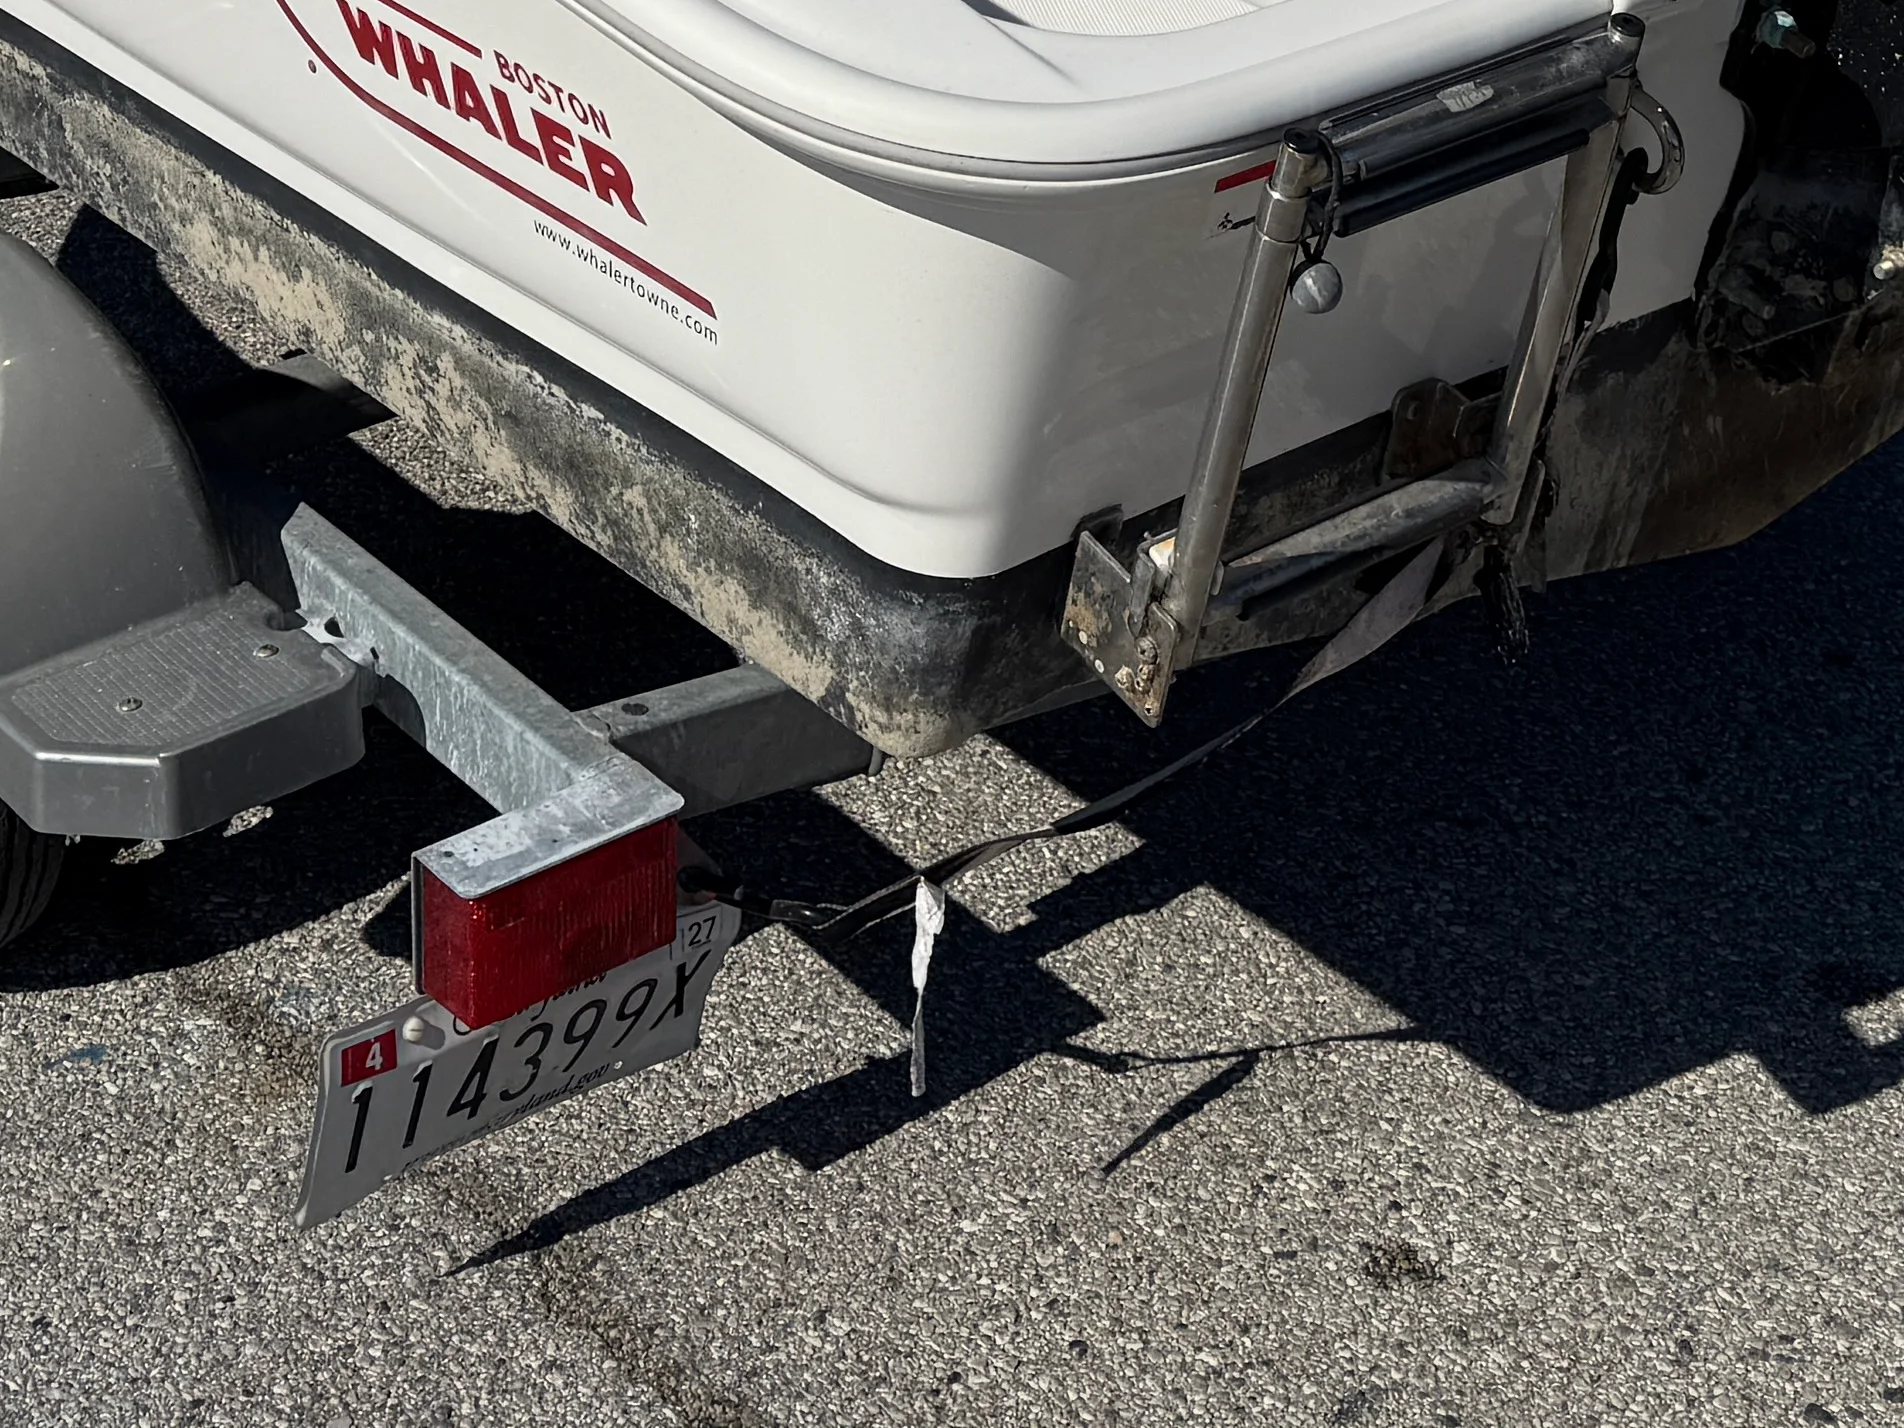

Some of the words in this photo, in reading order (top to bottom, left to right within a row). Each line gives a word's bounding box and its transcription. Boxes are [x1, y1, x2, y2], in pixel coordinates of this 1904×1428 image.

[493, 49, 612, 140] BOSTON
[533, 219, 719, 347] www.whalertowne.com
[688, 915, 717, 947] 27
[344, 948, 712, 1174] 114399X
[365, 1041, 384, 1071] 4
